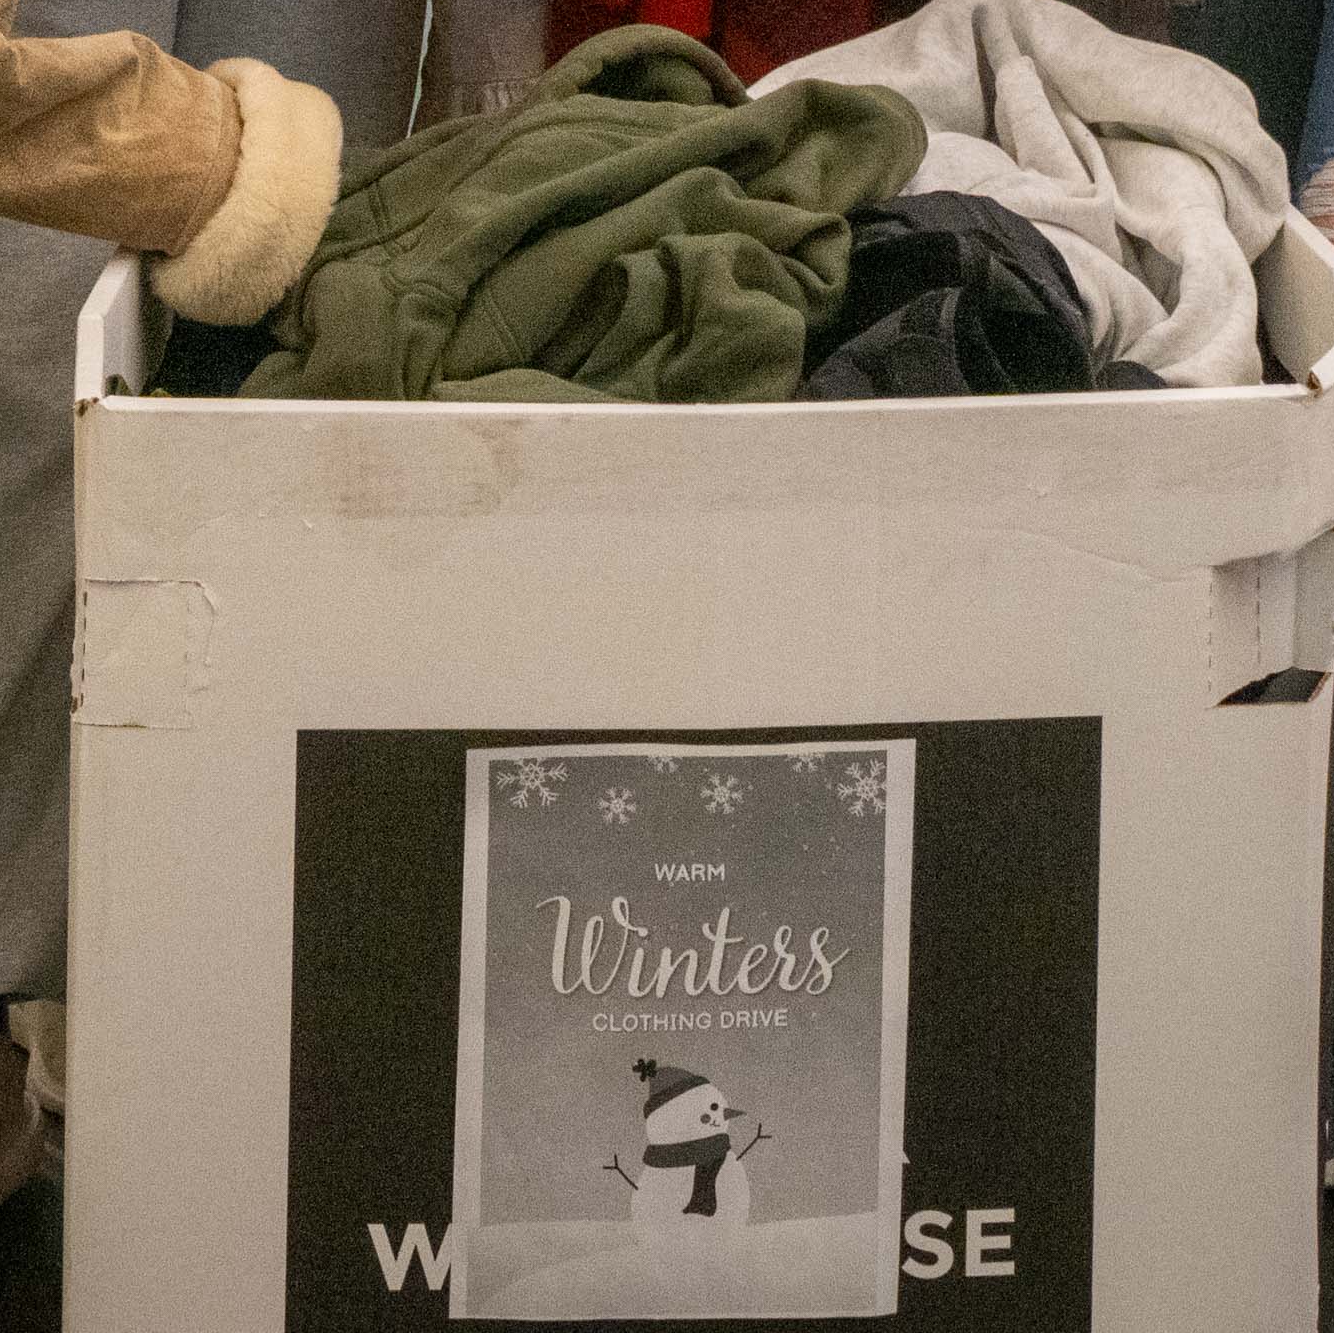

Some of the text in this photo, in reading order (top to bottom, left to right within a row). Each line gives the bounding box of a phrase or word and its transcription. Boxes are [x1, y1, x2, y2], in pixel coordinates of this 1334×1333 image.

[653, 861, 727, 883] WARM
[536, 893, 851, 1000] Winters
[592, 1008, 789, 1033] CLOTHING DRIVE
